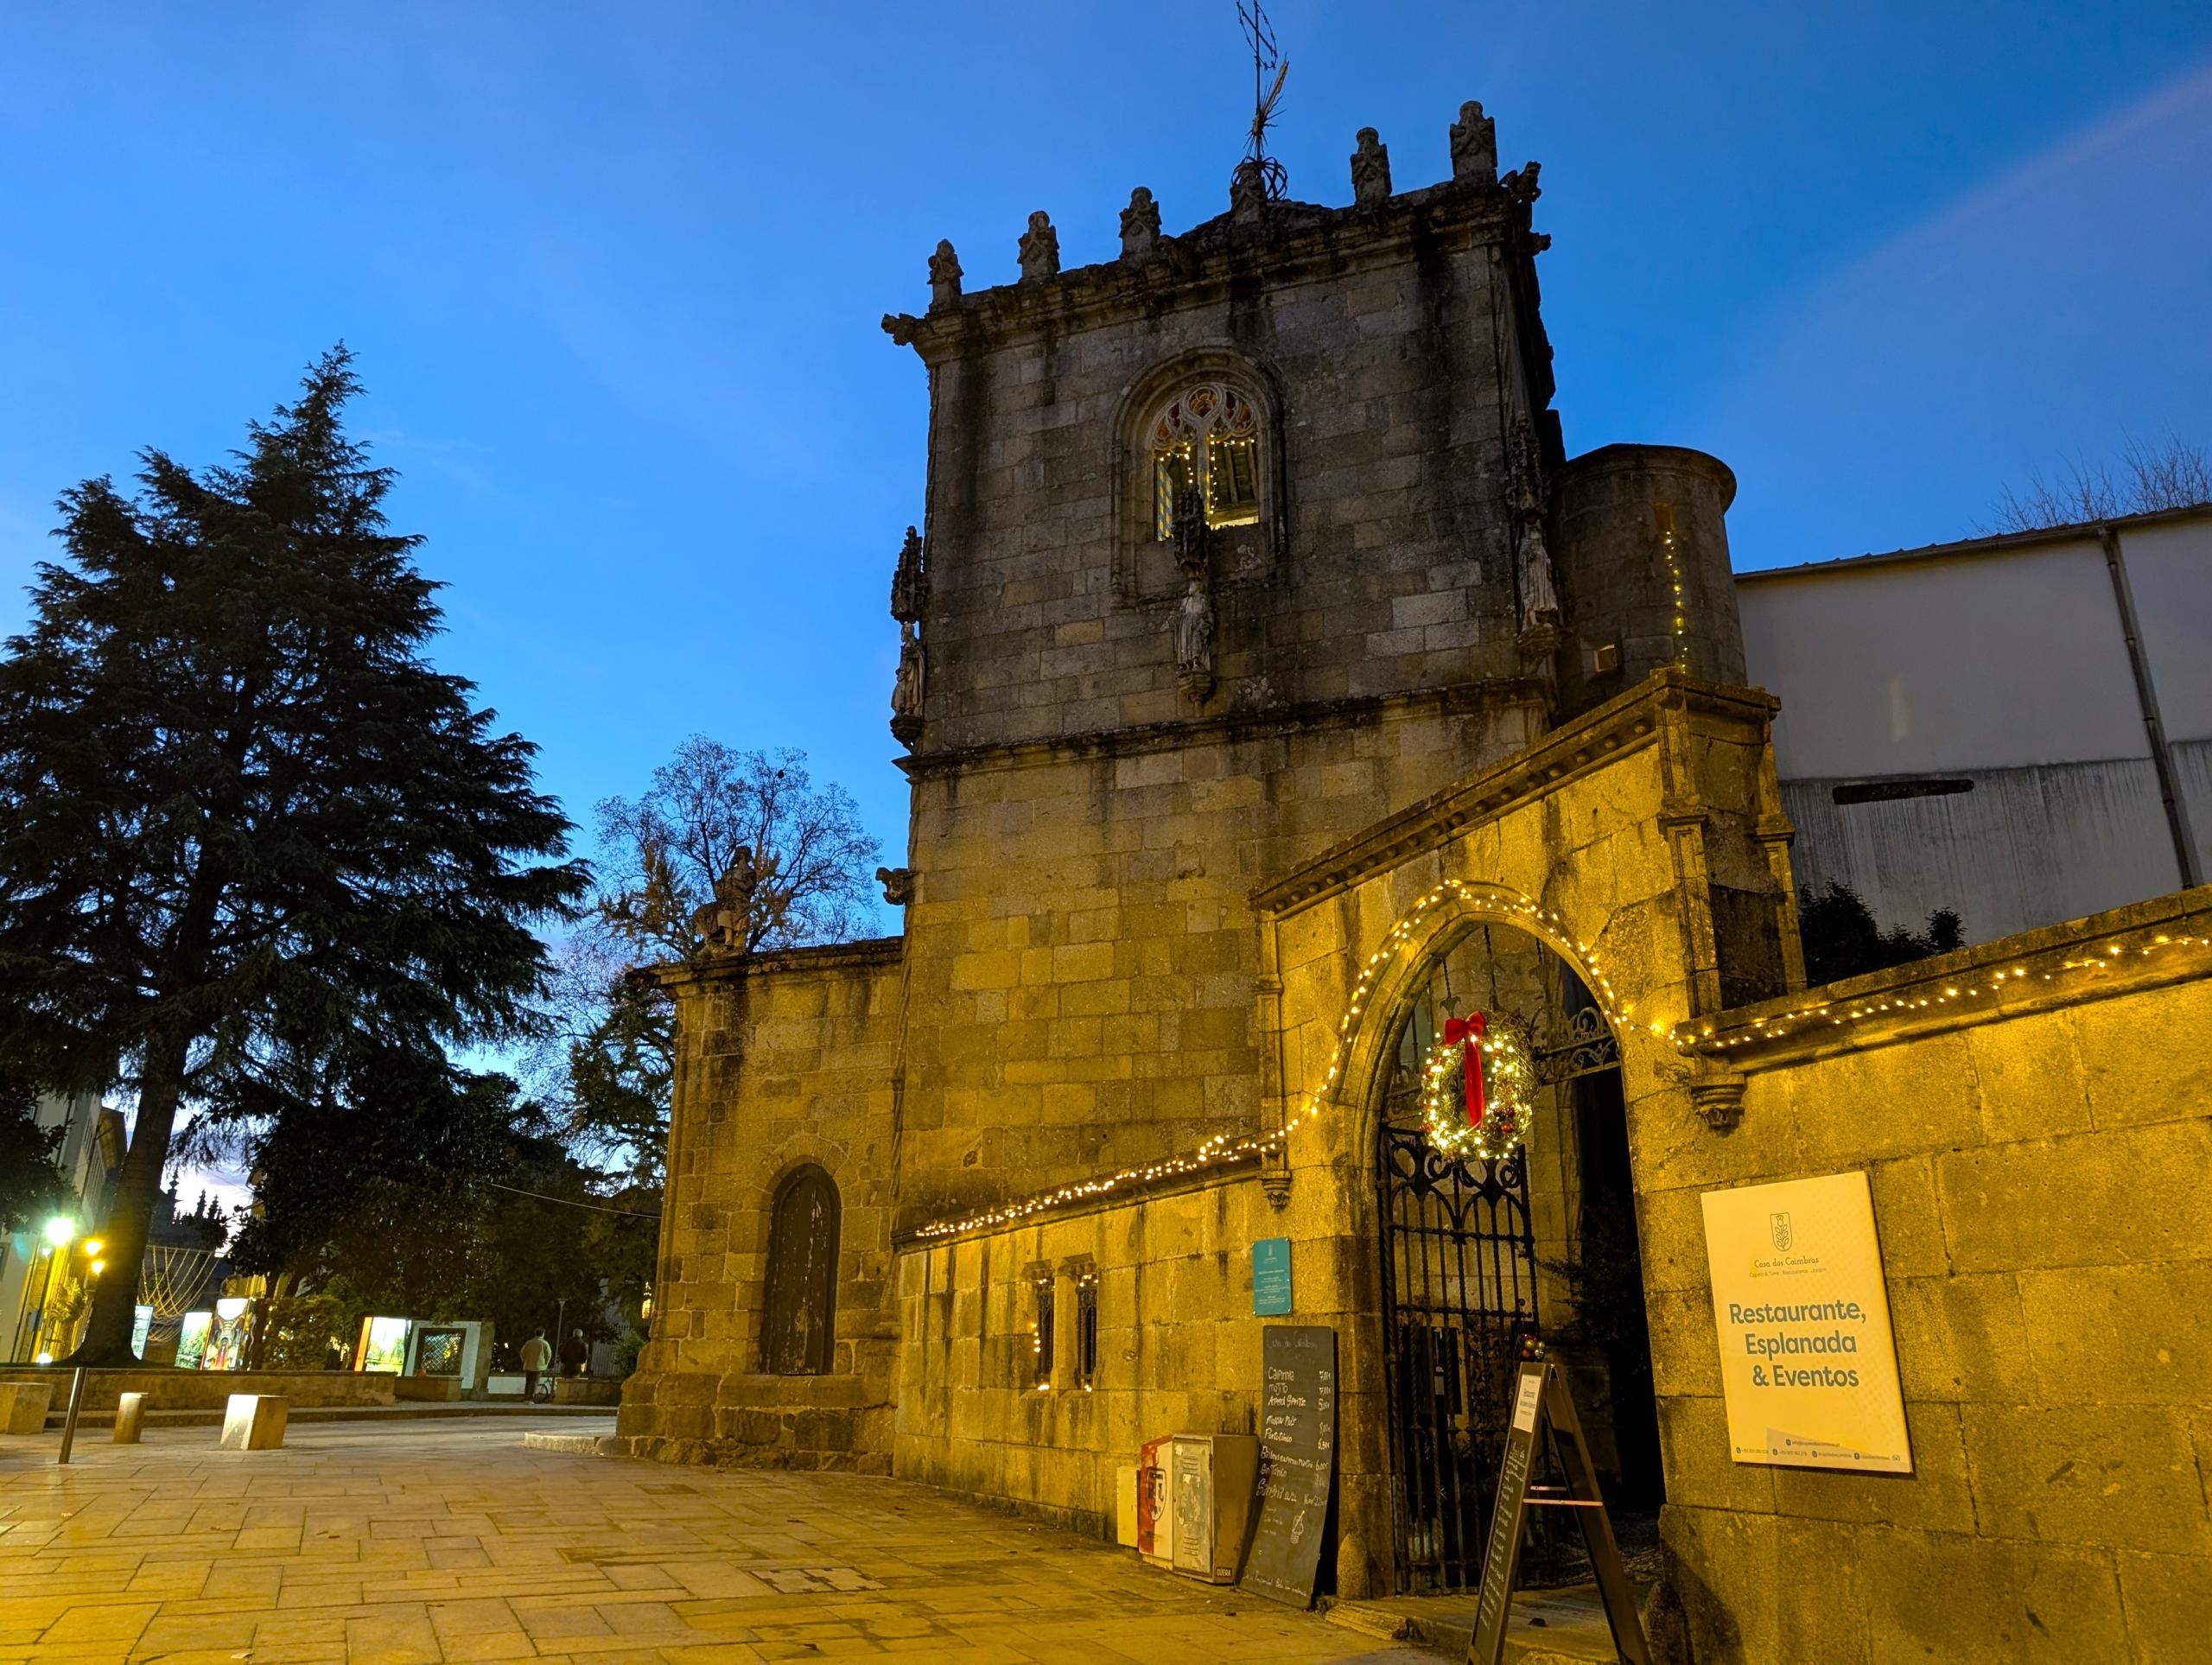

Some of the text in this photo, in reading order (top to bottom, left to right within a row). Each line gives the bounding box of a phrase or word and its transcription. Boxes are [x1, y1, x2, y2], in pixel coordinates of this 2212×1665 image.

[1754, 1255, 1819, 1268] Casa dos Coimbras
[1729, 1299, 1867, 1325] Restaurante,
[1745, 1330, 1857, 1361] Esplanada
[1751, 1364, 1859, 1388] & Eventos
